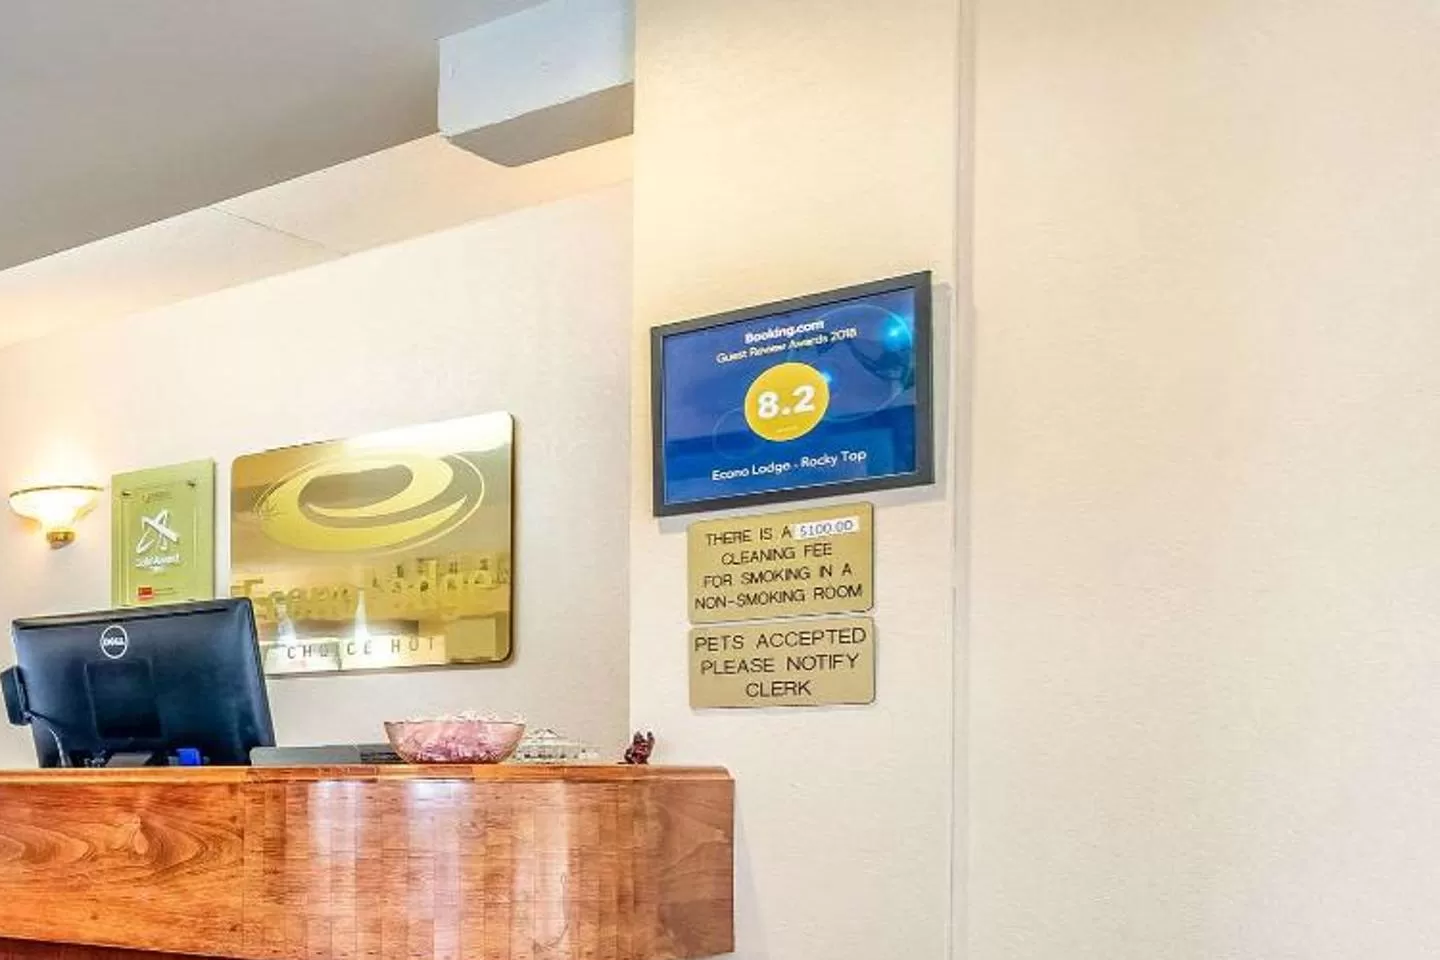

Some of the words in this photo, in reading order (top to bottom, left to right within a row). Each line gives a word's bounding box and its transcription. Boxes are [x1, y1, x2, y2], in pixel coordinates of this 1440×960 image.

[744, 320, 825, 344] Booking.com
[716, 352, 748, 363] Guest
[750, 342, 786, 357] Review
[788, 334, 828, 349] Awards
[758, 385, 816, 419] 8.2
[712, 469, 750, 481] Econo
[752, 462, 791, 475] Lodge
[801, 455, 838, 467] Rocky
[841, 450, 867, 462] Top
[705, 529, 753, 546] THERE
[759, 527, 773, 541] IS
[781, 525, 792, 539] A
[722, 547, 796, 565] CLEANING
[804, 542, 833, 558] FEE
[704, 573, 733, 589] FOR
[741, 566, 811, 586] SMOKING
[819, 565, 833, 578] IN
[841, 562, 853, 577] A
[695, 589, 805, 609] NON-SMOKING
[813, 583, 863, 601] ROOM
[694, 634, 745, 653] PETS
[756, 627, 866, 649] ACCEPTED
[700, 657, 775, 676] PLEASE
[786, 653, 860, 672] NOTIFY
[746, 680, 812, 698] CLERK
